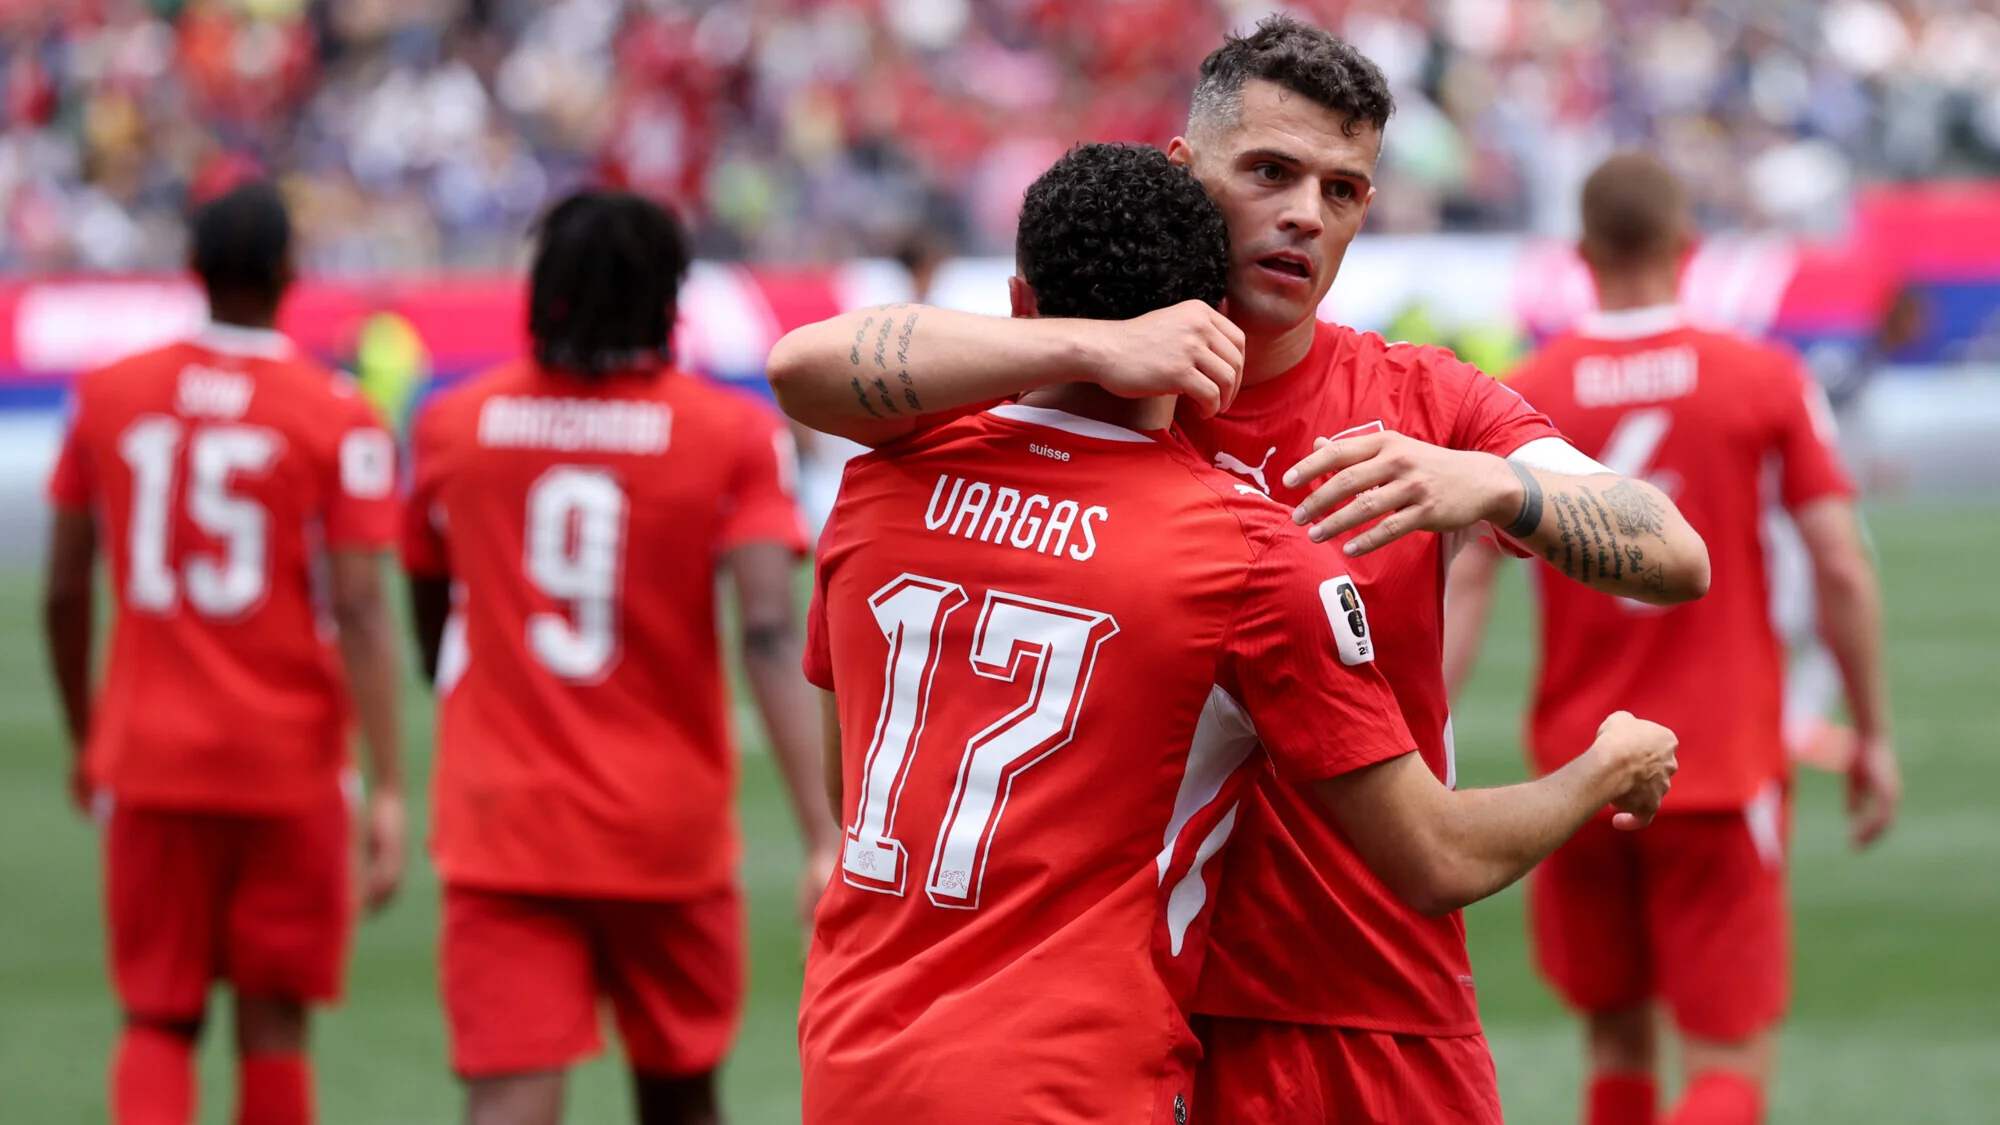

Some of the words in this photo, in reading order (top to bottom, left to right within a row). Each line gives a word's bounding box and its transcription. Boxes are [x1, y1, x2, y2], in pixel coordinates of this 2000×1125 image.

[119, 413, 288, 623] 15
[925, 474, 1108, 561] VARGAS
[1029, 442, 1070, 462] suisse
[524, 463, 630, 686] 9
[843, 572, 1120, 911] 17
